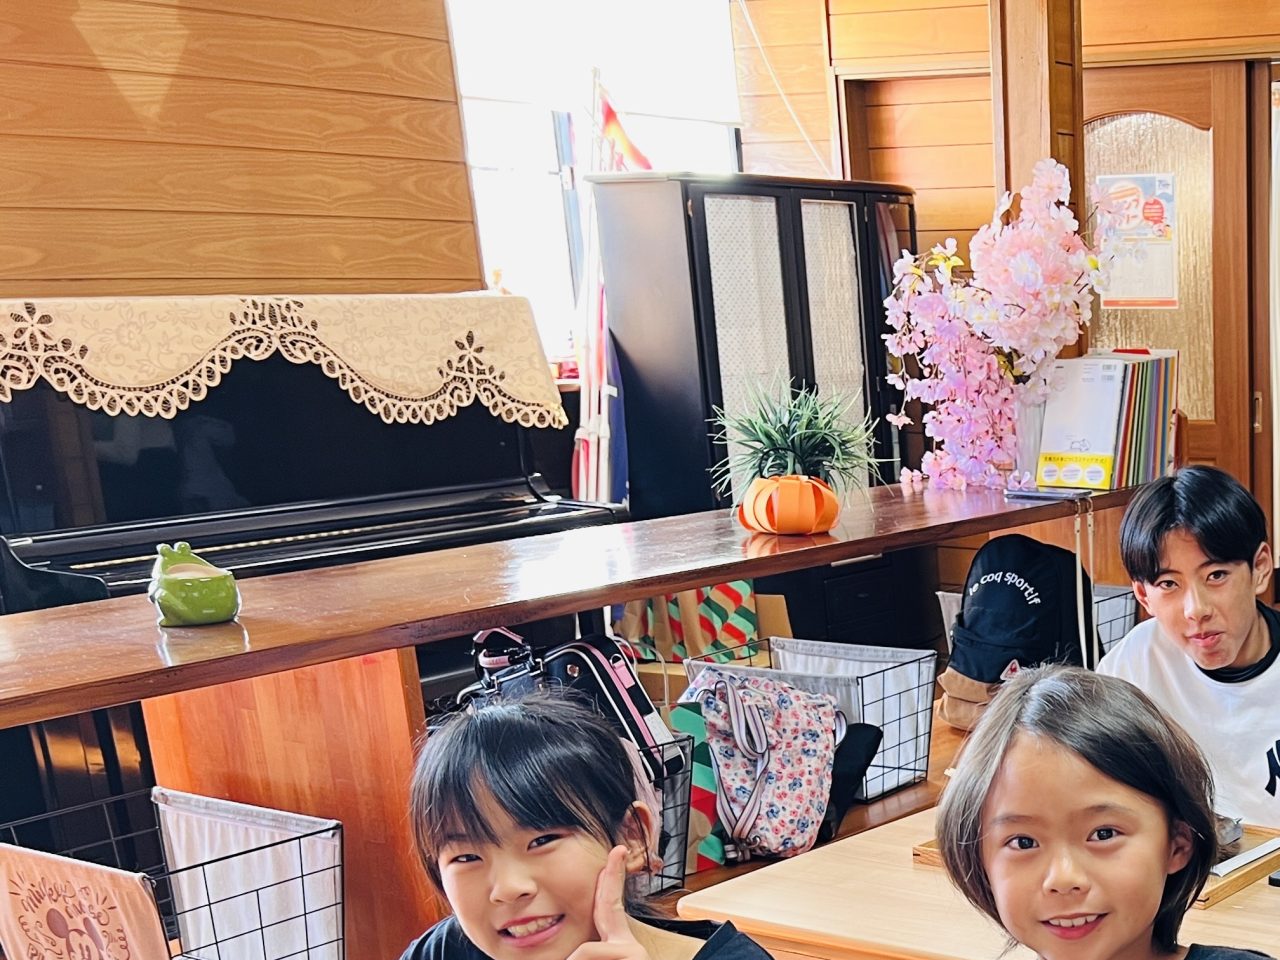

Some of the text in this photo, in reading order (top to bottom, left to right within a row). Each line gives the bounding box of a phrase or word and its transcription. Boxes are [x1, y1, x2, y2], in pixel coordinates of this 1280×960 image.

[968, 571, 1042, 606] le coq sportif
